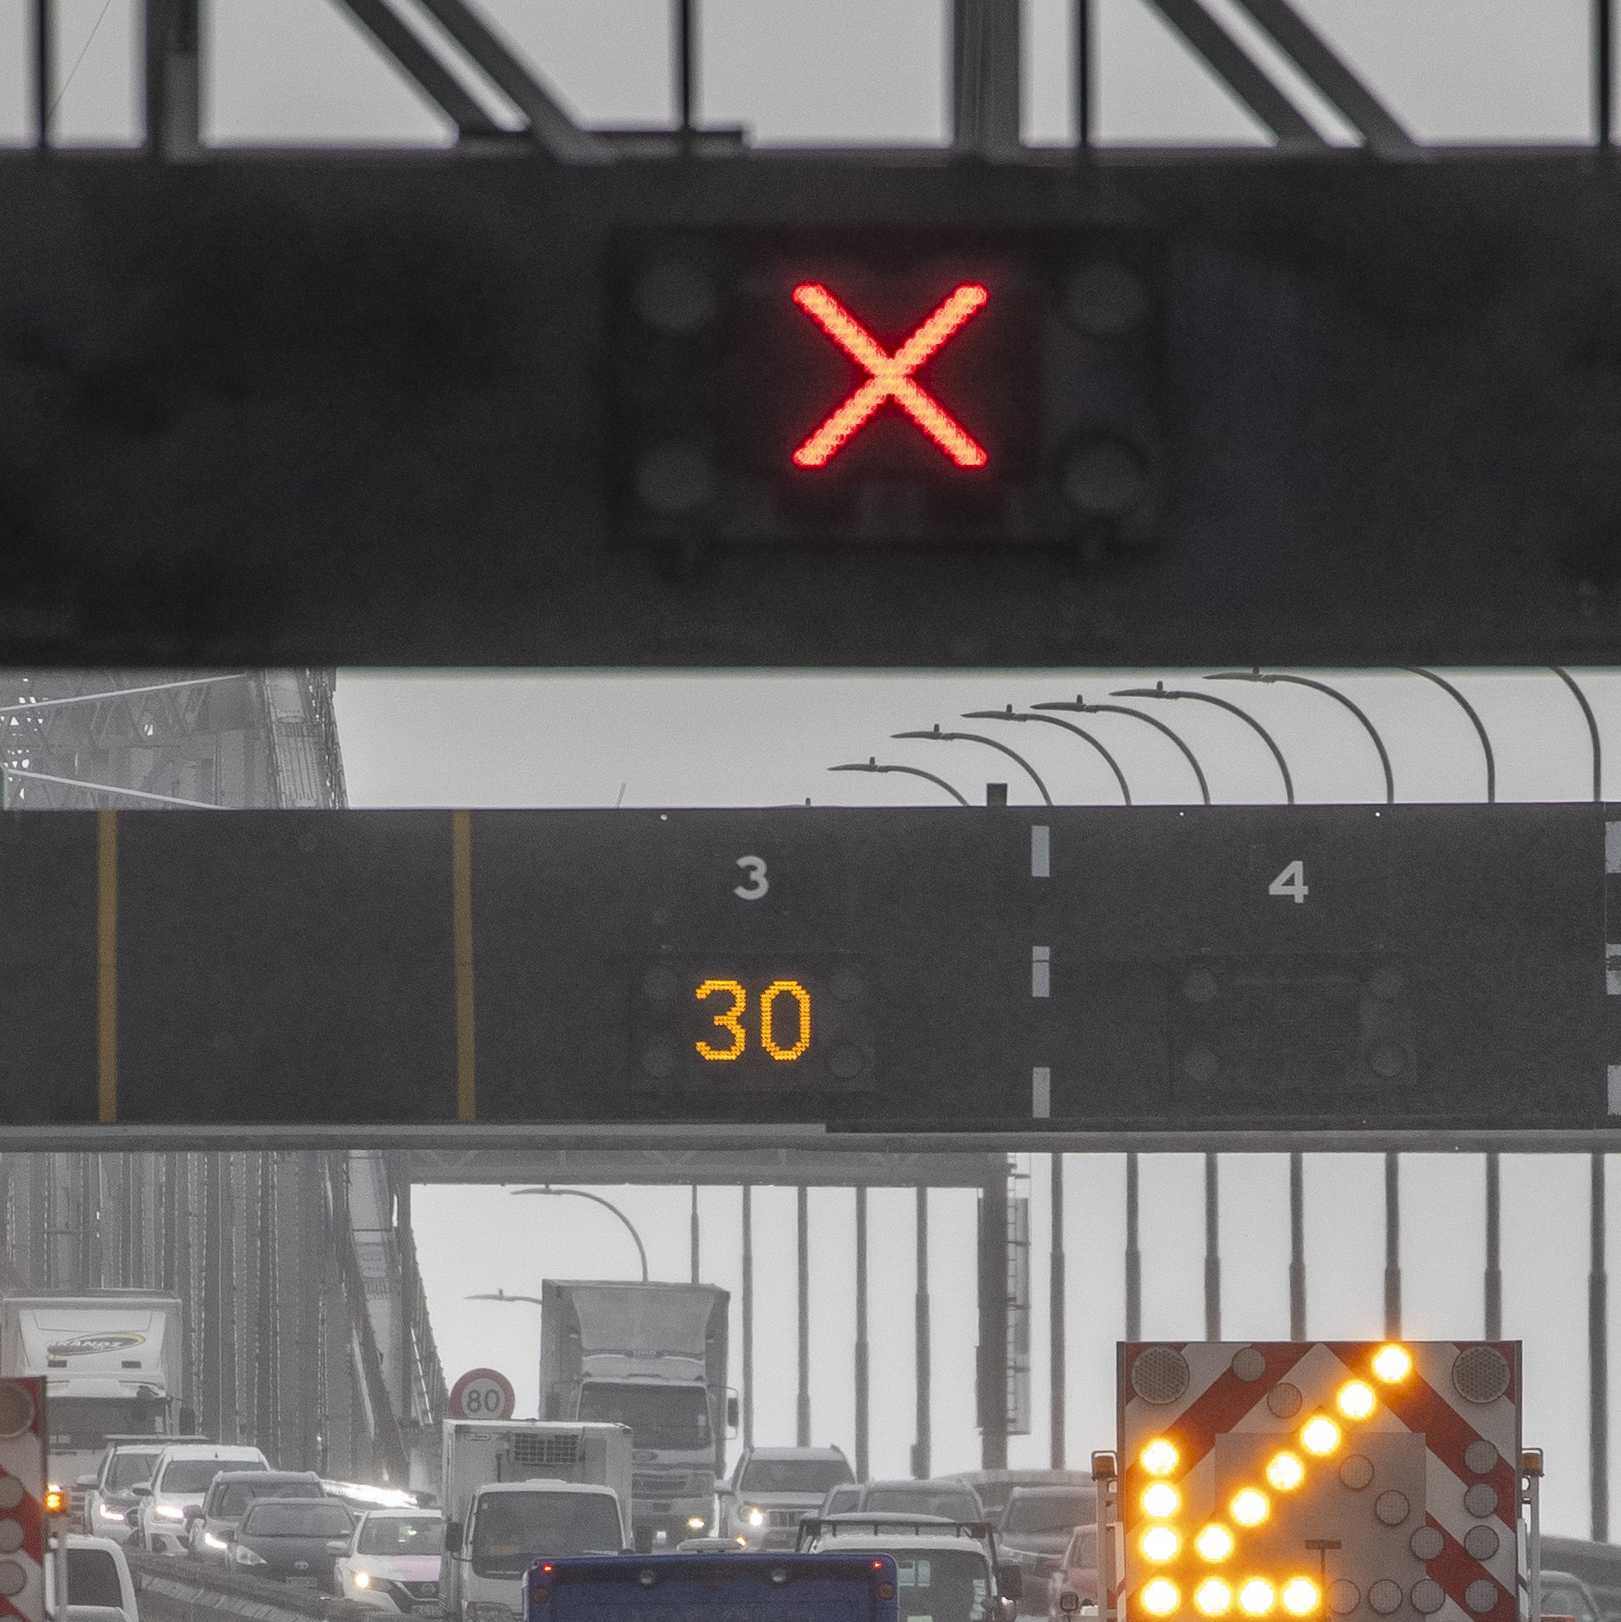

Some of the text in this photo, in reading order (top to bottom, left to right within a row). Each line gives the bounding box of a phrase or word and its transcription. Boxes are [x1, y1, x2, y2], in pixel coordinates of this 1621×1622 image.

[733, 855, 772, 901] 3
[1267, 859, 1311, 905] 4
[694, 979, 813, 1062] 30
[466, 1389, 500, 1413] 80
